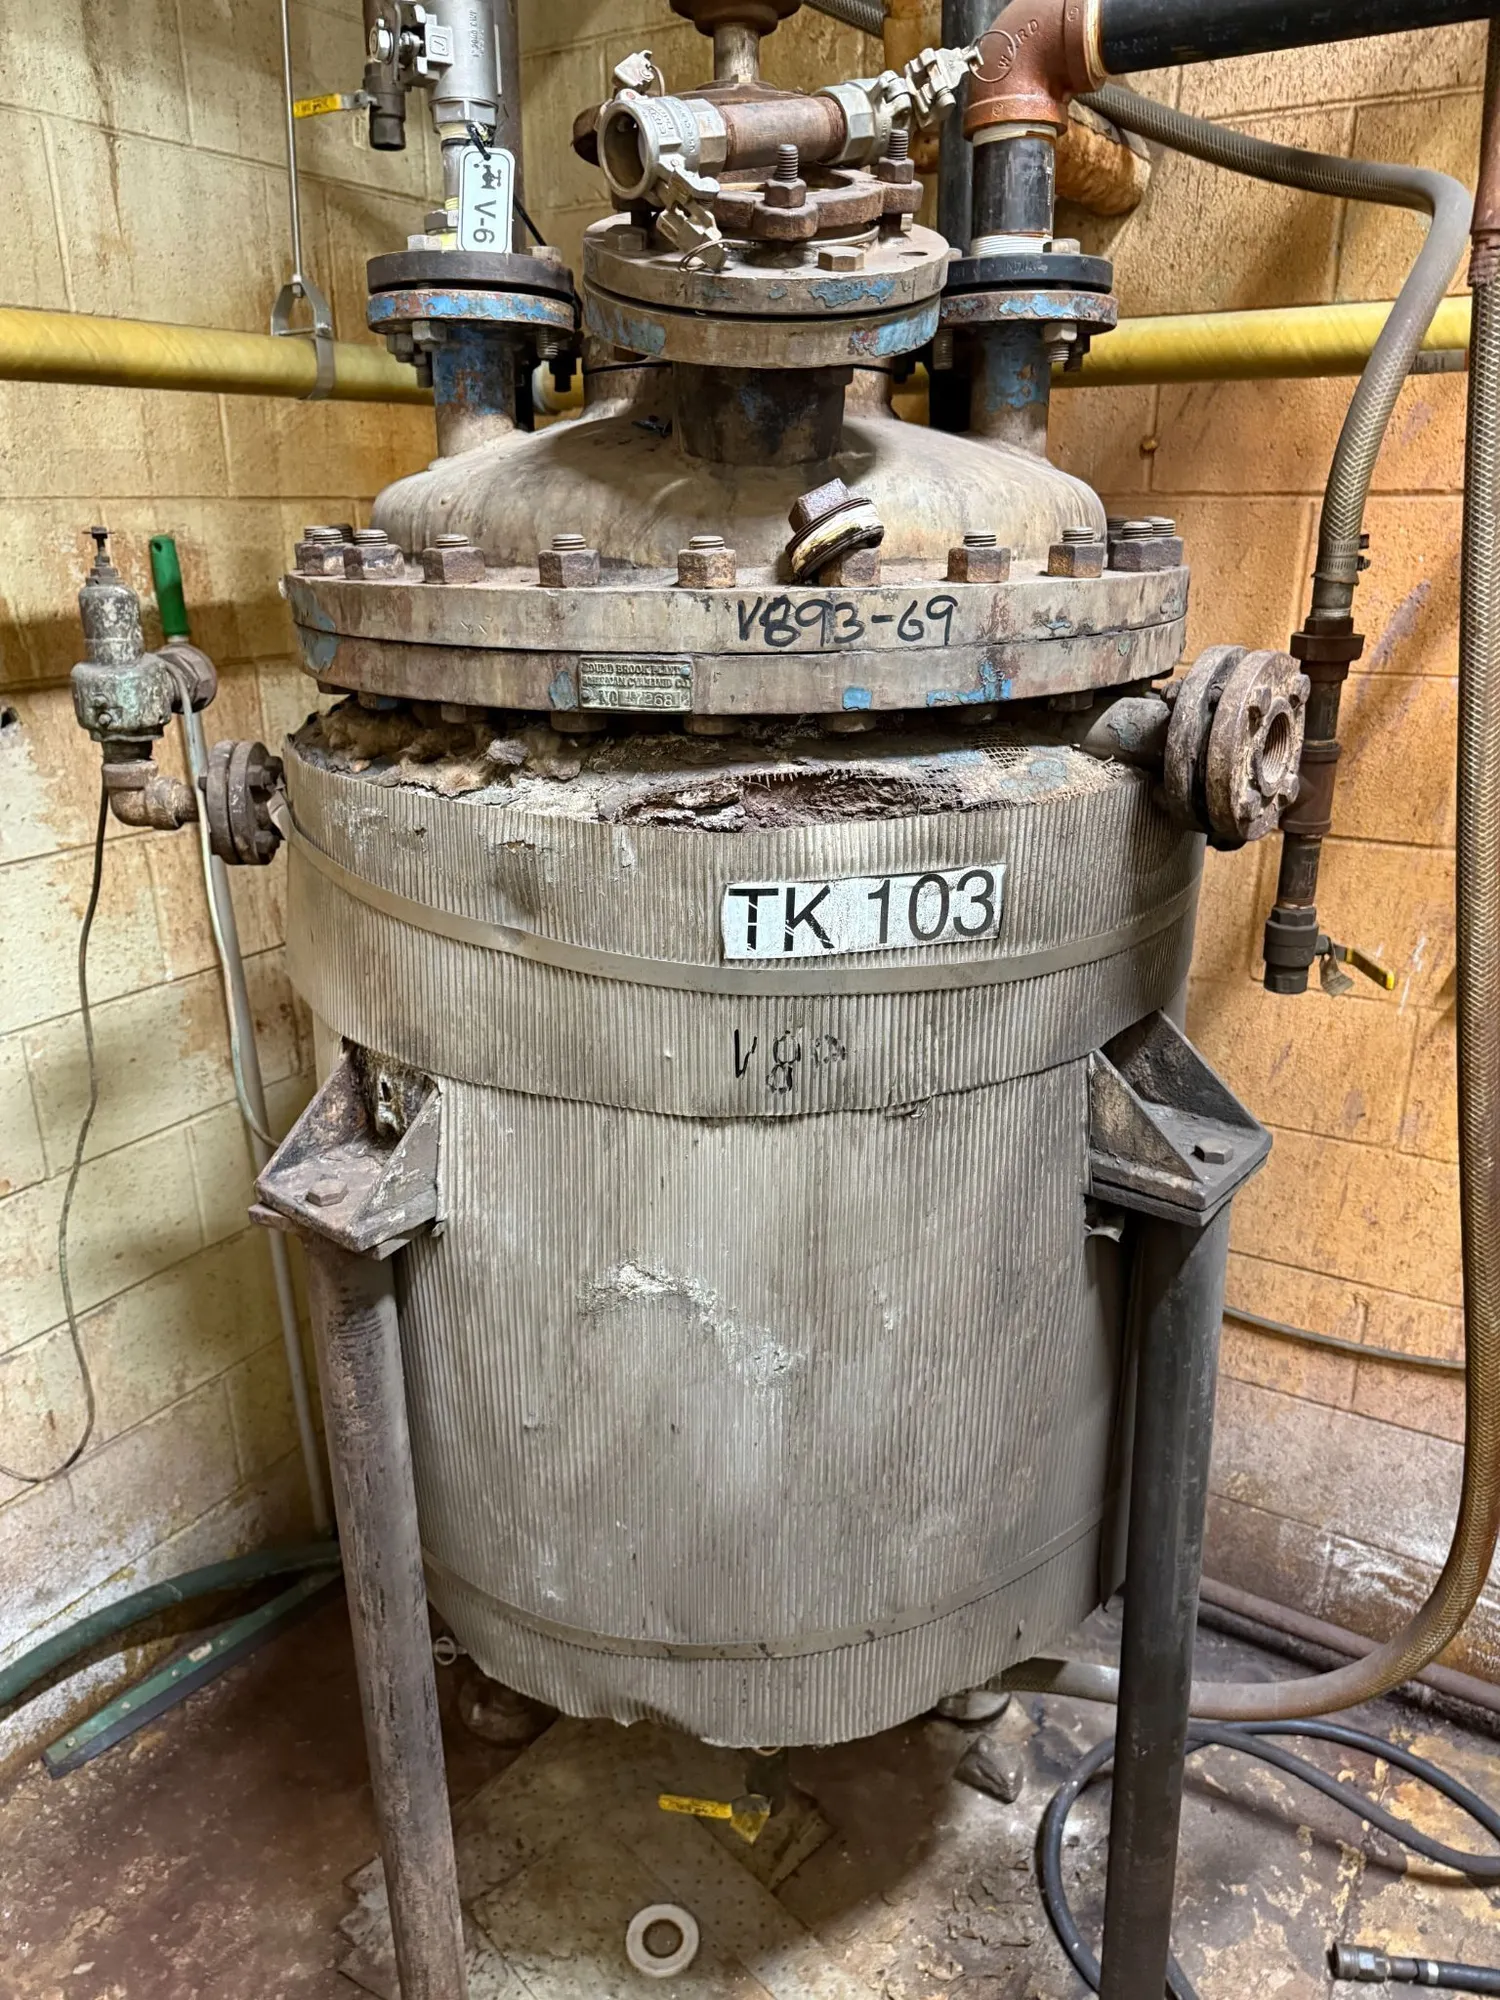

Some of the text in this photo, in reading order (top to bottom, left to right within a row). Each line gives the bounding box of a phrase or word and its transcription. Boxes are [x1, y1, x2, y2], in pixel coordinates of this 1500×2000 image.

[473, 200, 497, 244] V-6
[738, 594, 958, 647] V893-69
[728, 869, 996, 952] TK 103
